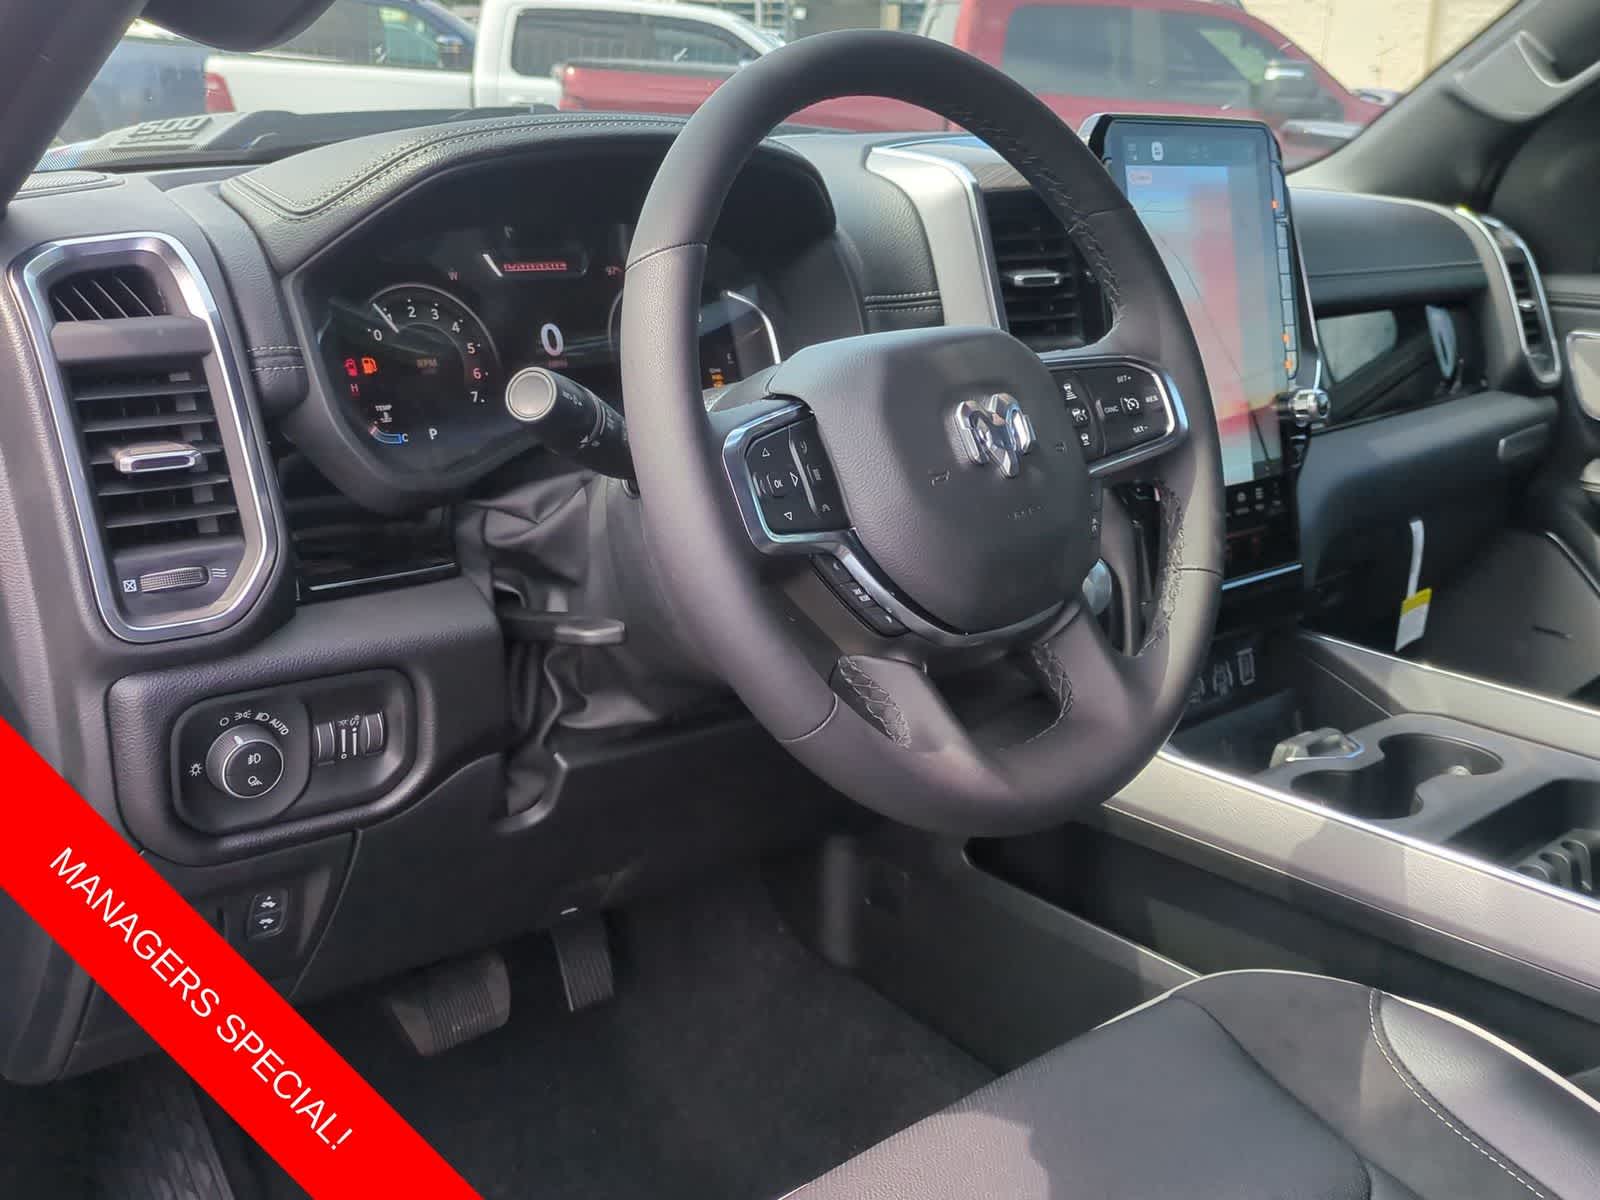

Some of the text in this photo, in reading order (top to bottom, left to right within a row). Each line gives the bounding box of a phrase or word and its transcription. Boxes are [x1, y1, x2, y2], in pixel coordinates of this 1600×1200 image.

[407, 306, 417, 318] 2
[431, 308, 440, 320] 3
[451, 321, 461, 333] 4
[373, 329, 383, 341] 0
[540, 322, 564, 356] 0
[467, 342, 476, 354] 5
[472, 367, 482, 379] 6
[350, 383, 359, 393] H
[470, 391, 479, 403] 7
[428, 427, 438, 440] P
[268, 717, 290, 737] AUTO
